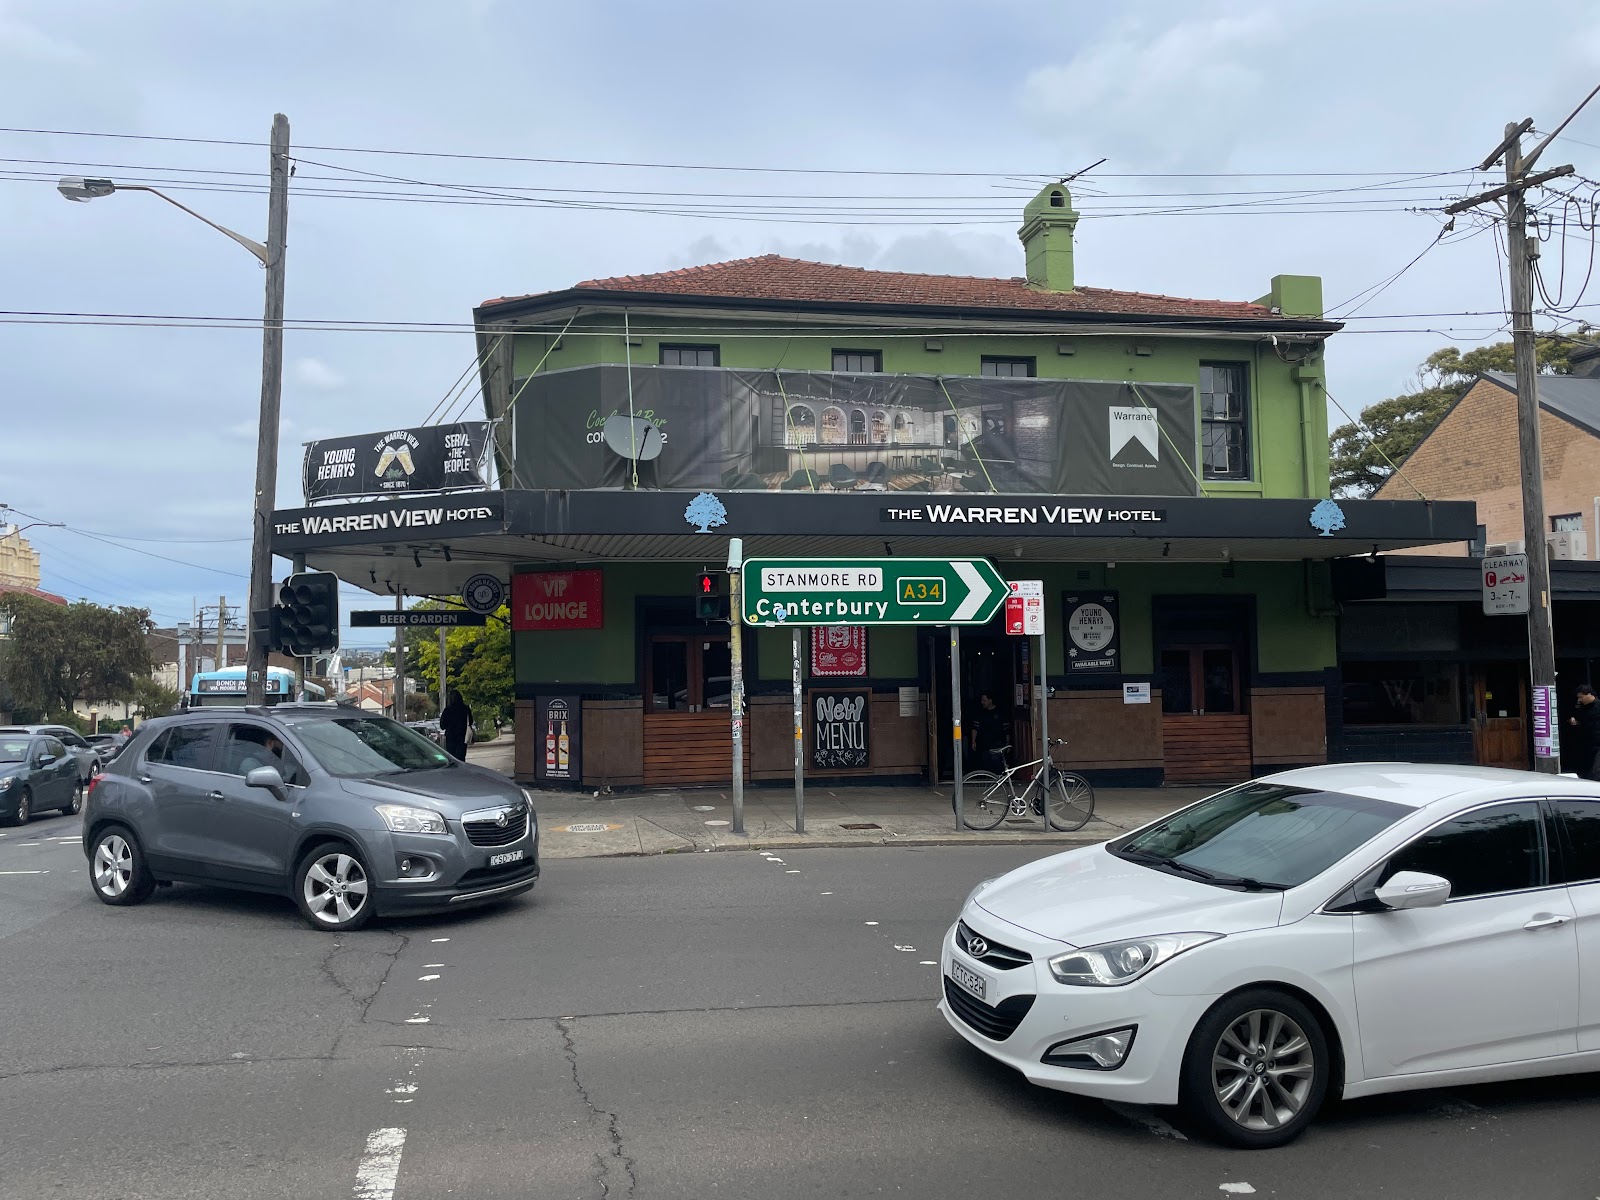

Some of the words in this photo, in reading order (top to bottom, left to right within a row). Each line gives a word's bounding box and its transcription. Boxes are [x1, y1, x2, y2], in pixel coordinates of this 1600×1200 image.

[1113, 411, 1153, 421] Warrane
[373, 438, 386, 454] THE
[384, 431, 408, 445] WARREN
[405, 432, 420, 450] VIEW
[444, 433, 470, 449] SERVE
[323, 448, 356, 465] YOUNG
[451, 448, 462, 459] THE
[317, 463, 356, 481] HENRYS
[443, 457, 470, 474] PEOPLE
[382, 481, 395, 489] SINCE
[274, 522, 300, 535] THE
[301, 512, 388, 535] WARREN
[390, 508, 444, 528] VIEW
[887, 508, 922, 520] THE
[926, 504, 1038, 524] WARREN
[1040, 505, 1104, 524] VIEW
[1107, 510, 1162, 522] HOTEL
[1484, 558, 1524, 570] CLEARWAY
[767, 573, 850, 587] STANMORE
[858, 573, 878, 587] RD
[543, 580, 568, 598] VIP
[904, 584, 941, 600] A34
[525, 601, 588, 621] LOUNGE
[756, 599, 889, 619] Canterbury
[1080, 608, 1102, 617] YOUNG
[379, 614, 406, 624] BEER
[410, 613, 458, 624] GARDEN
[1079, 616, 1104, 625] HENRYS
[548, 710, 567, 720] BRIX
[816, 722, 865, 750] MENU
